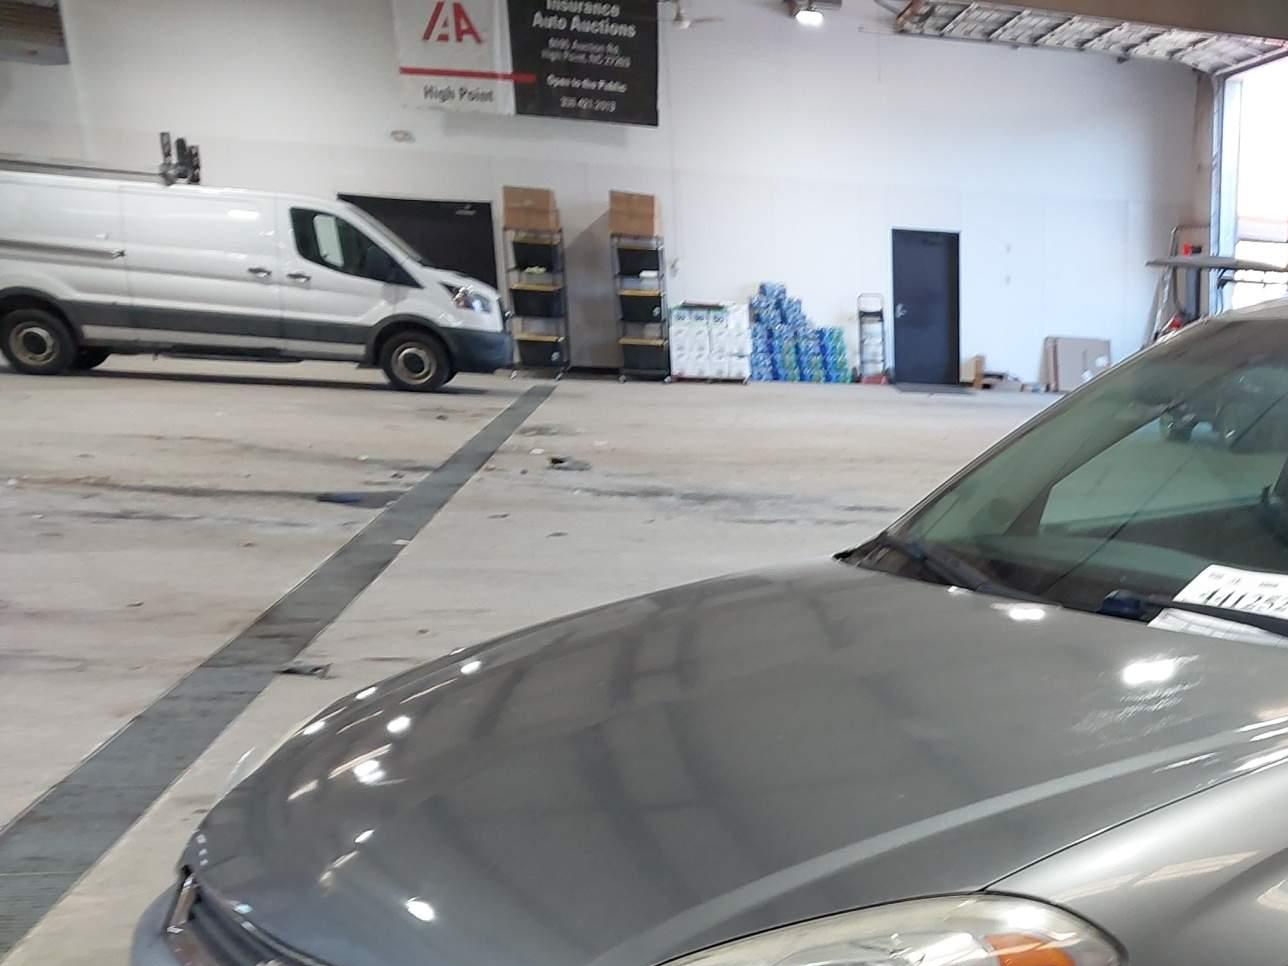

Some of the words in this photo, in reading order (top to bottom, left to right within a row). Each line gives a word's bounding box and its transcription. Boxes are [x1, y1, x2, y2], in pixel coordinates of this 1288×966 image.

[545, 0, 620, 17] Insurance
[532, 10, 568, 30] Auto
[570, 15, 637, 38] Auctions
[423, 84, 456, 103] High
[459, 86, 494, 102] Point
